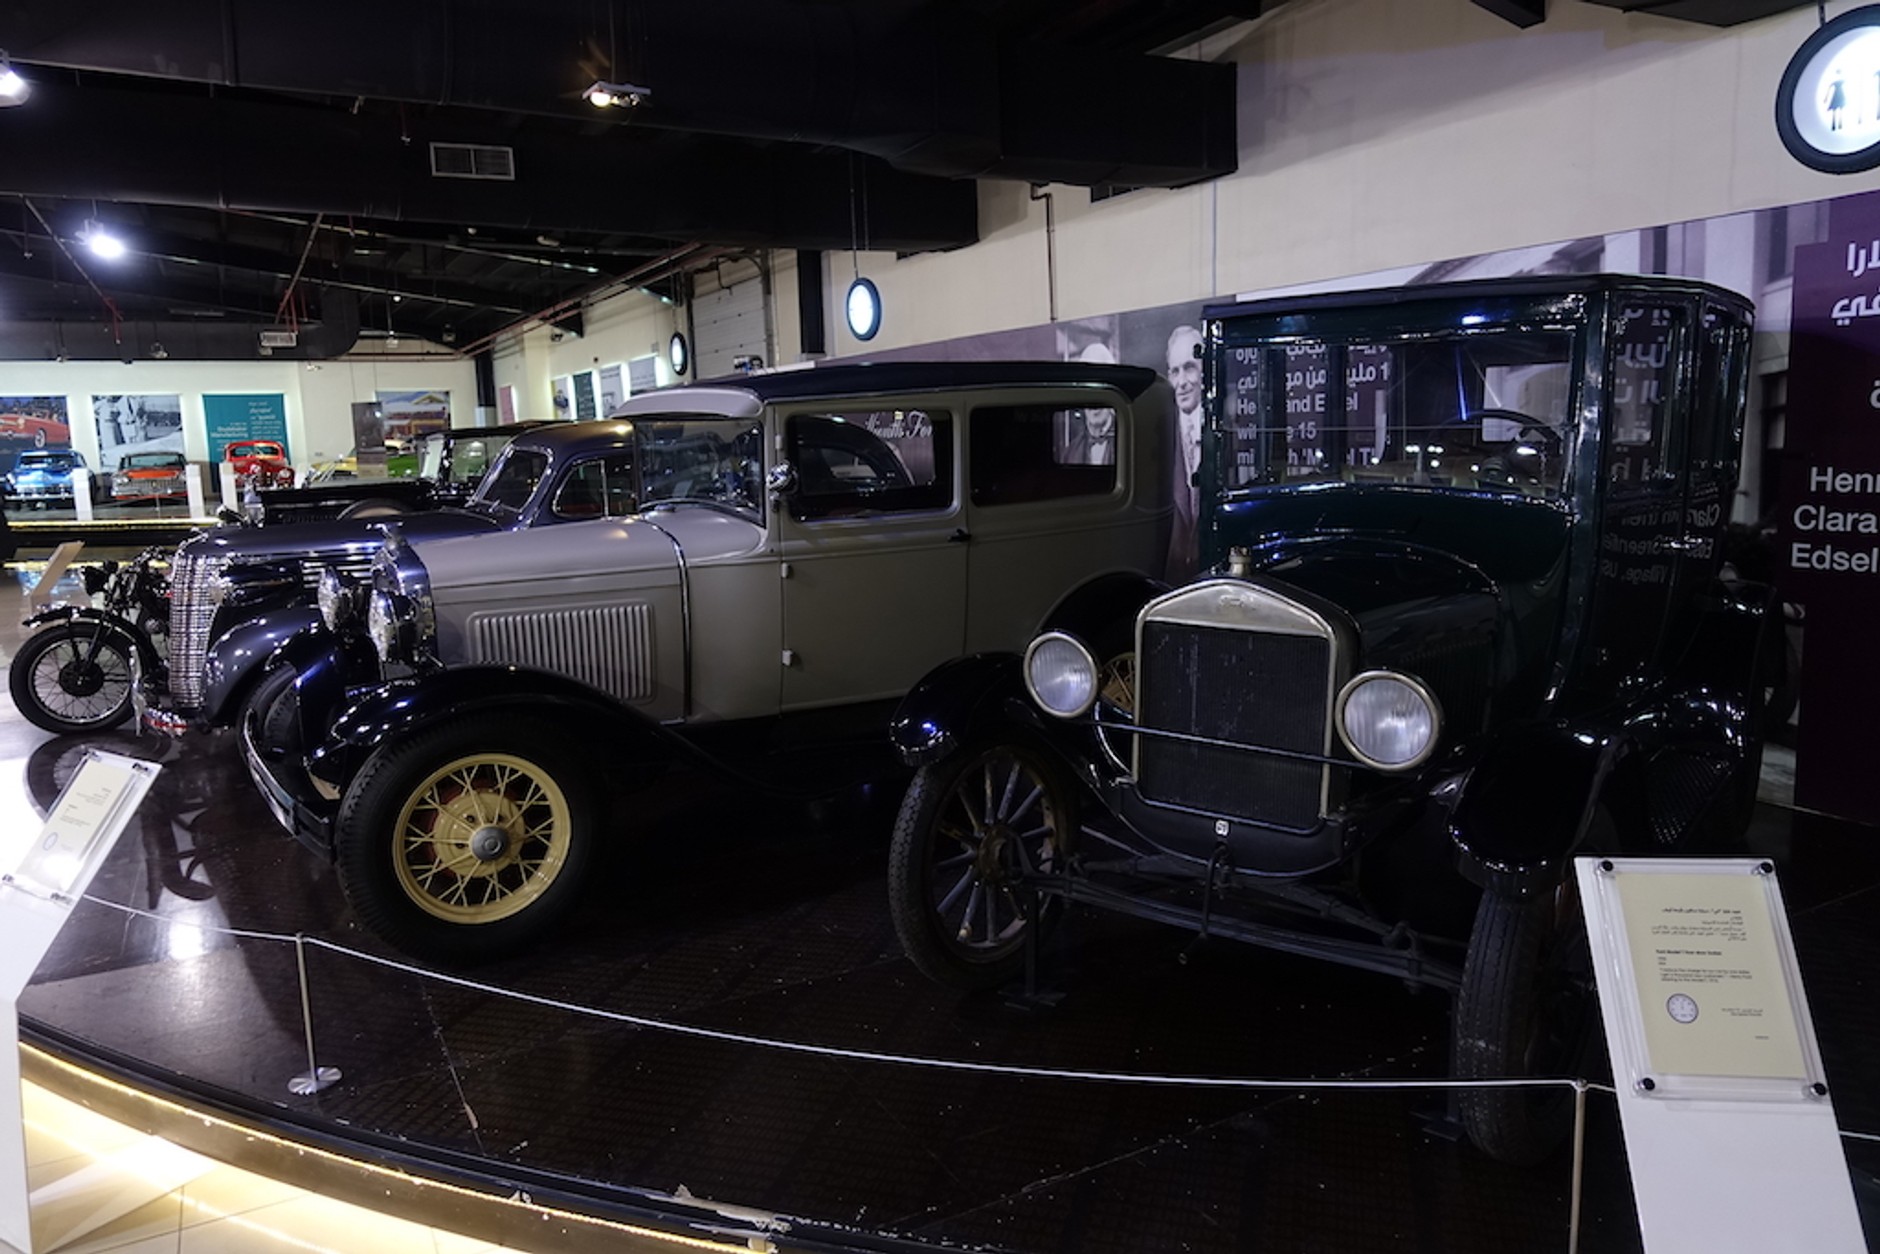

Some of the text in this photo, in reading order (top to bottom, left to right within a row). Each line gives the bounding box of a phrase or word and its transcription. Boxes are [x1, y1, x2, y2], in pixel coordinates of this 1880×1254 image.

[1299, 421, 1317, 440] 15
[1793, 504, 1878, 533] Clara
[1791, 542, 1879, 574] Edsel
